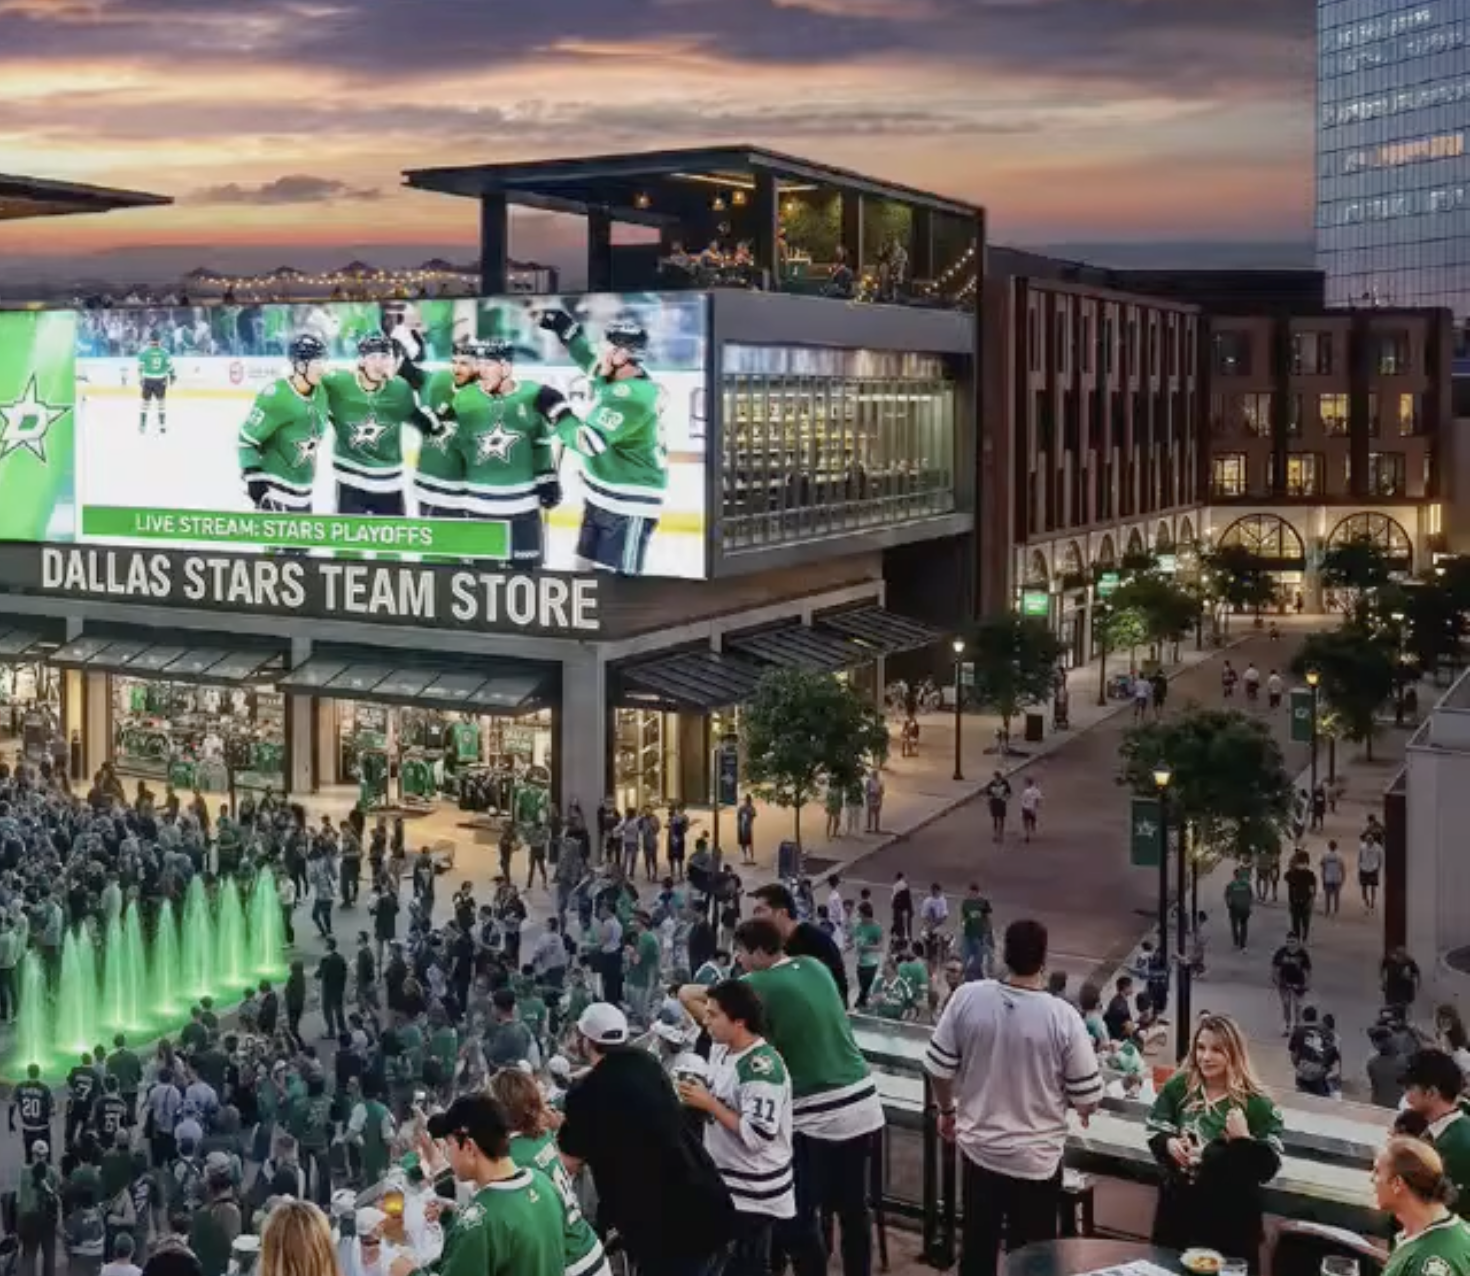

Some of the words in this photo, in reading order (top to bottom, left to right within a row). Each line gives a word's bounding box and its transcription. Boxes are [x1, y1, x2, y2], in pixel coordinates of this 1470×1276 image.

[135, 513, 175, 533] LIVE
[179, 517, 259, 537] STREAM:
[263, 520, 325, 540] STARS
[331, 522, 433, 545] PLAYOFFS
[42, 548, 171, 598] DALLAS
[183, 556, 304, 608] STARS
[319, 566, 435, 618] TEAM
[451, 572, 600, 629] STORE
[22, 1098, 41, 1118] 20
